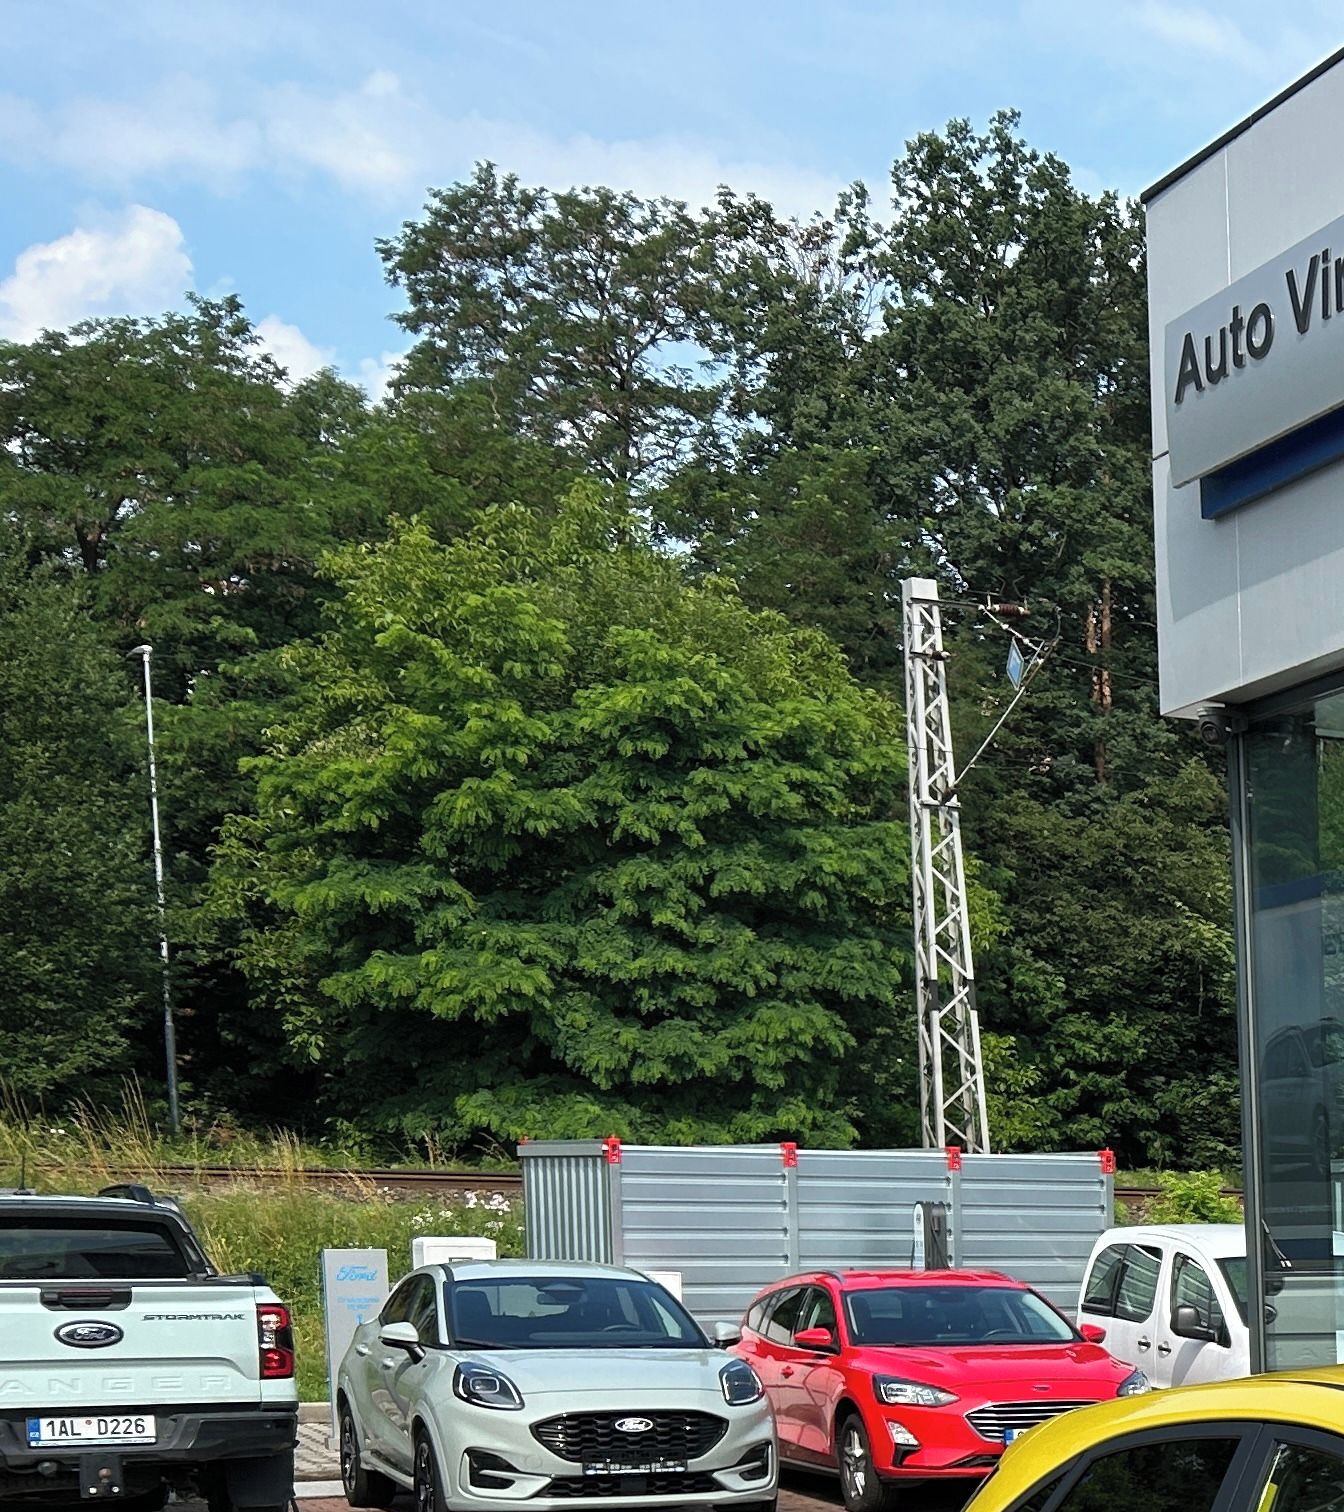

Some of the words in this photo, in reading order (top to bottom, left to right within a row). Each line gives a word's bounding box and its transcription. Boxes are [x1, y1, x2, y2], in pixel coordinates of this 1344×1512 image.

[1174, 302, 1275, 405] Auto
[336, 1265, 377, 1281] Ford
[142, 1313, 246, 1322] STORMTRAK
[46, 1419, 82, 1437] 1AL
[97, 1418, 146, 1436] D226
